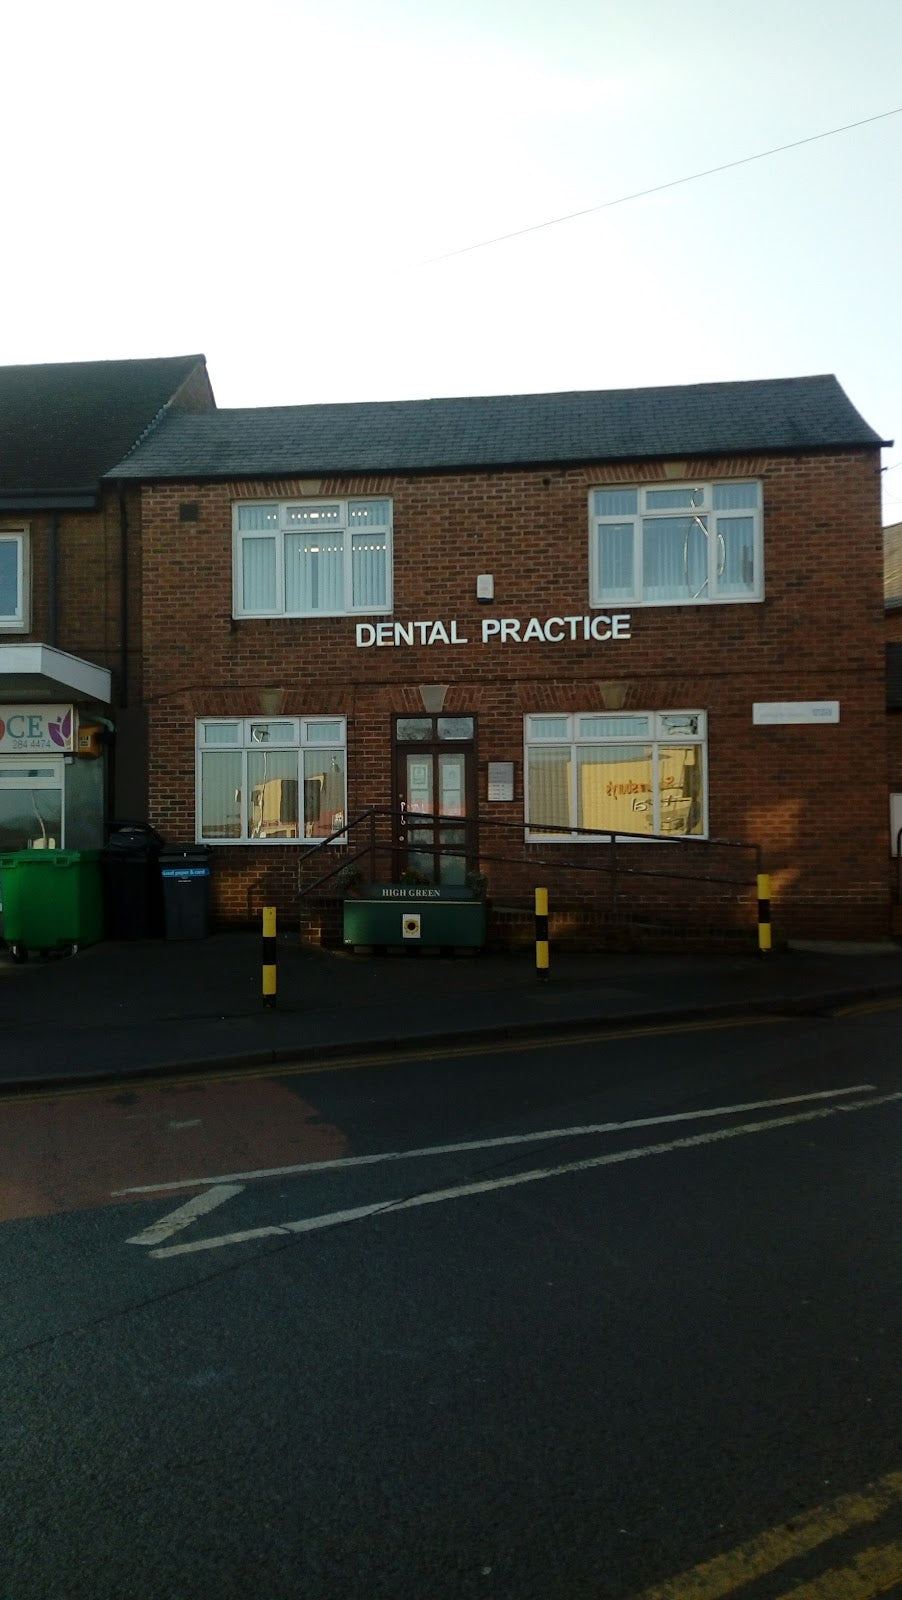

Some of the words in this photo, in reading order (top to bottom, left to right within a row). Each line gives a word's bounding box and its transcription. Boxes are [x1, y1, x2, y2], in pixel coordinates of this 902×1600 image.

[355, 620, 468, 648] DENTAL
[481, 614, 632, 644] PRACTICE
[12, 740, 28, 749] 284
[31, 739, 51, 748] 4474
[382, 888, 407, 897] HIGH
[408, 888, 441, 897] GREEN
